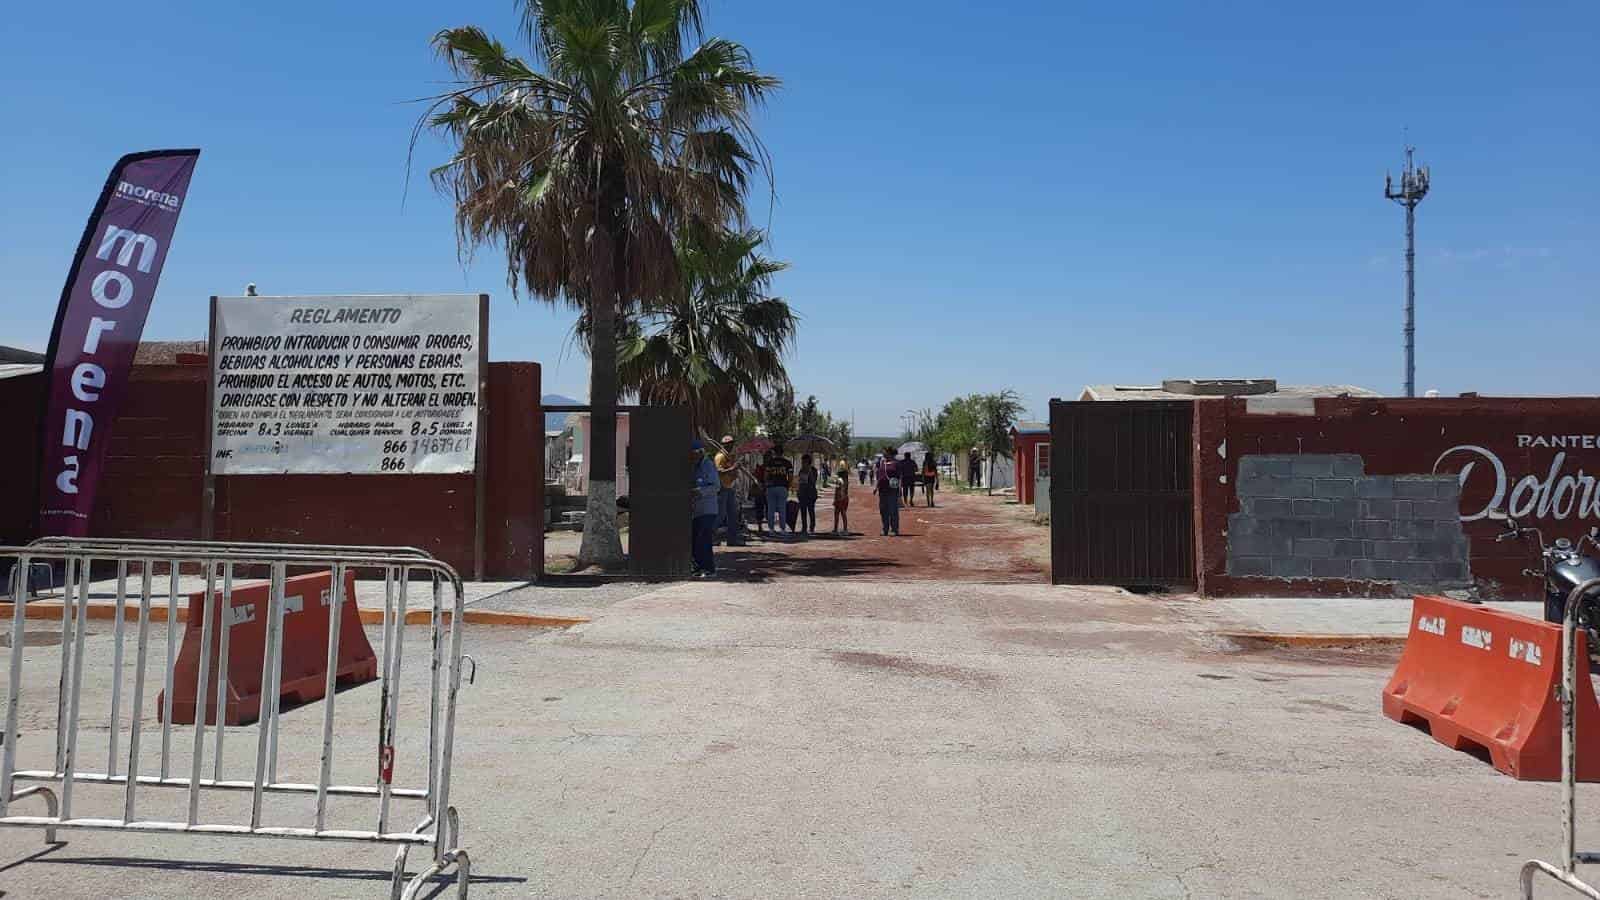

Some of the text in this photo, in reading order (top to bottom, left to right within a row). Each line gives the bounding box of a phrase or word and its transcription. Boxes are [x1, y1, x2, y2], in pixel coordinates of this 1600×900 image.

[118, 181, 178, 207] morena
[290, 308, 402, 324] REGLAMENTO
[221, 336, 281, 351] PROHIBIDO
[284, 335, 349, 350] INTRODUCIR
[364, 335, 420, 349] CONSUMIR
[426, 334, 473, 351] DROGAS,
[55, 224, 158, 494] morena
[220, 354, 463, 369] BEBIDAS ALCOHOLICAS Y PERSONAS EBRIAS.
[218, 374, 465, 389] PROHIBIDO EL ACCESO DE AUTOS, MOTOS, ETC.
[221, 392, 476, 407] DIRIGIRSE CON RESPETO Y NO ALTERAR EL ORDEN.
[216, 450, 232, 458] INF.
[384, 440, 407, 453] 866
[381, 457, 405, 470] 866
